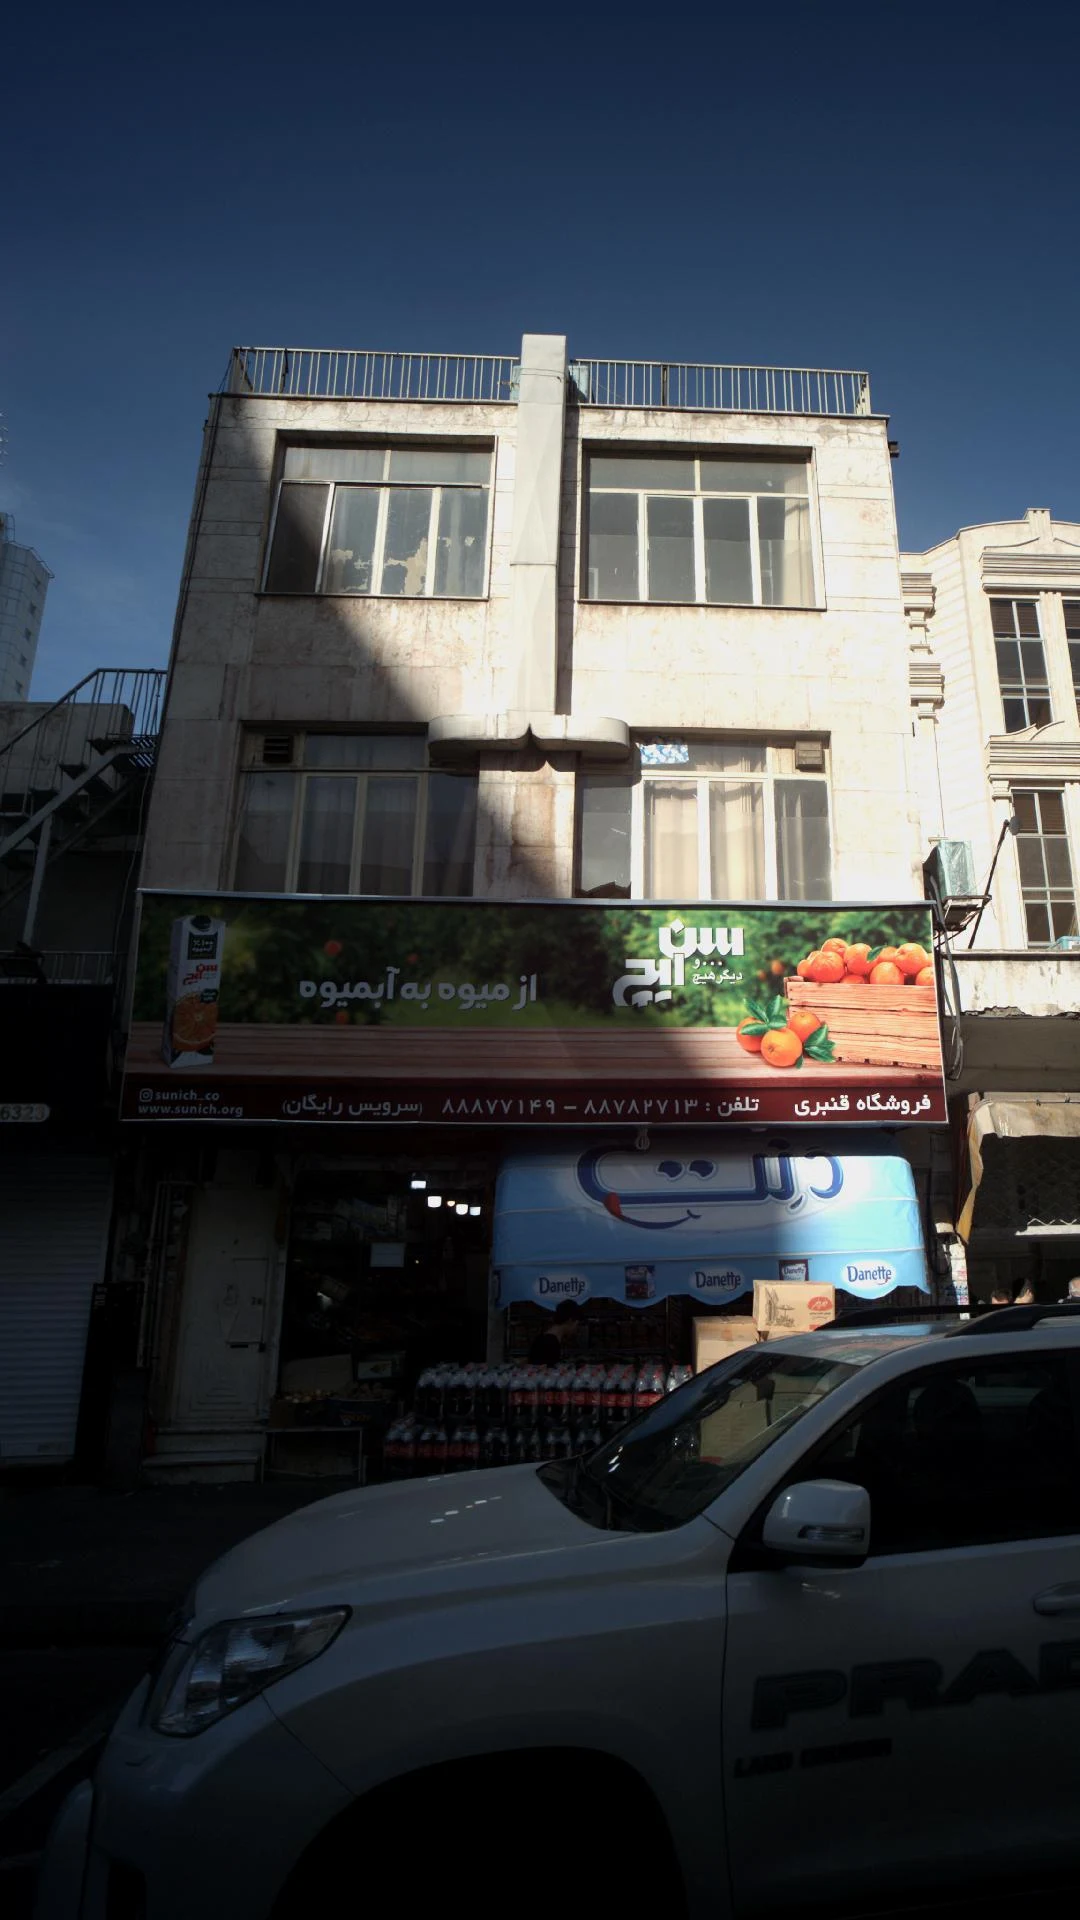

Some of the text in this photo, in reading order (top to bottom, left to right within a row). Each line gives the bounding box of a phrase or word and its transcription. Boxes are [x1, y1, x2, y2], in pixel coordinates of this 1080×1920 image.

[299, 966, 537, 1010] از میوه به آبمیوه
[138, 1103, 244, 1118] www.sunich.org
[441, 1098, 556, 1115] ۸۸۸۷۷۱۴۹
[584, 1099, 699, 1115] ۸۸۷۸۲۷۱۳
[794, 1092, 932, 1117] فروشگاه قنبری
[539, 1275, 586, 1297] Danette
[695, 1270, 742, 1292] Danette
[846, 1265, 893, 1286] Danette
